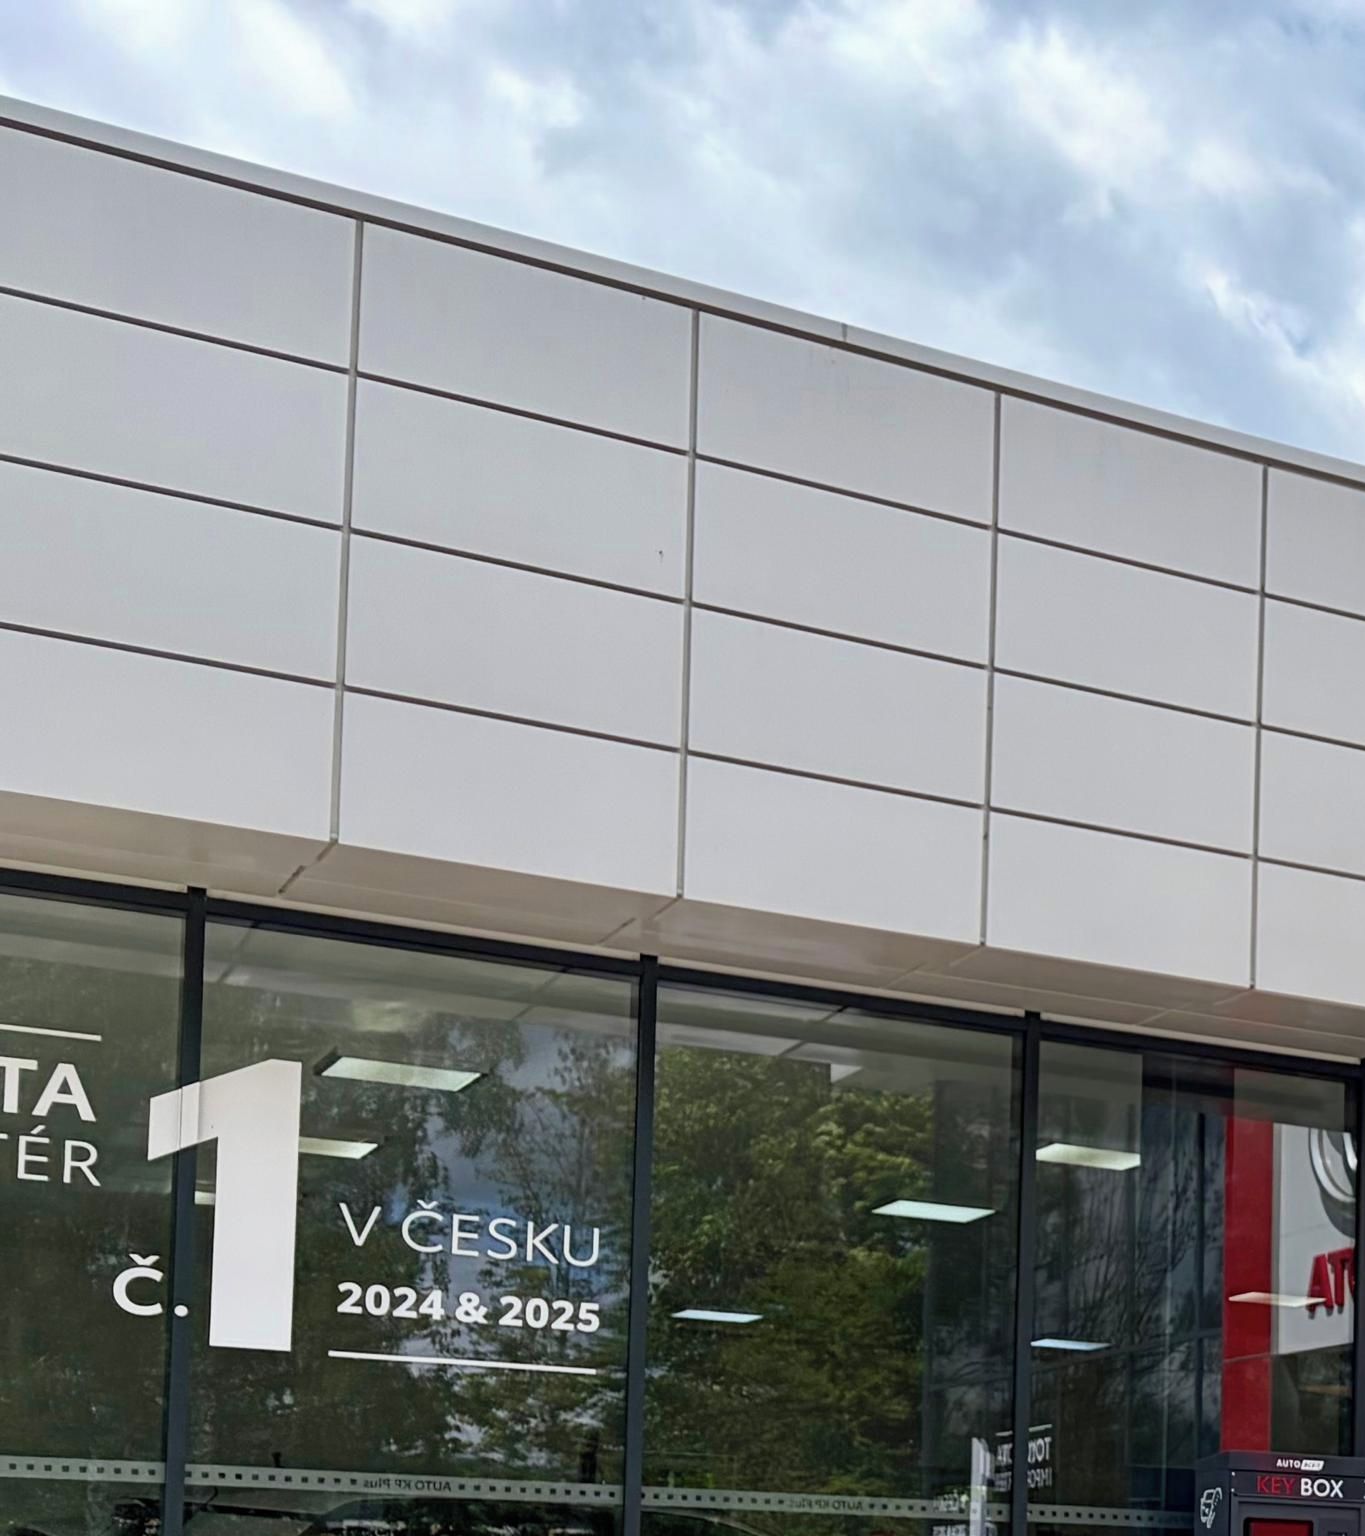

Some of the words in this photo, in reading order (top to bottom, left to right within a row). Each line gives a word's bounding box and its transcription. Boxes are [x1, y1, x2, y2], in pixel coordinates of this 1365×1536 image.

[148, 1058, 302, 1352] 1
[401, 1199, 600, 1268] ČESKU
[337, 1281, 445, 1321] 2024
[454, 1291, 489, 1325] &
[498, 1295, 600, 1334] 2025
[1257, 1476, 1297, 1496] KEY
[1300, 1477, 1344, 1499] BOX
[1276, 1459, 1301, 1469] AUTO
